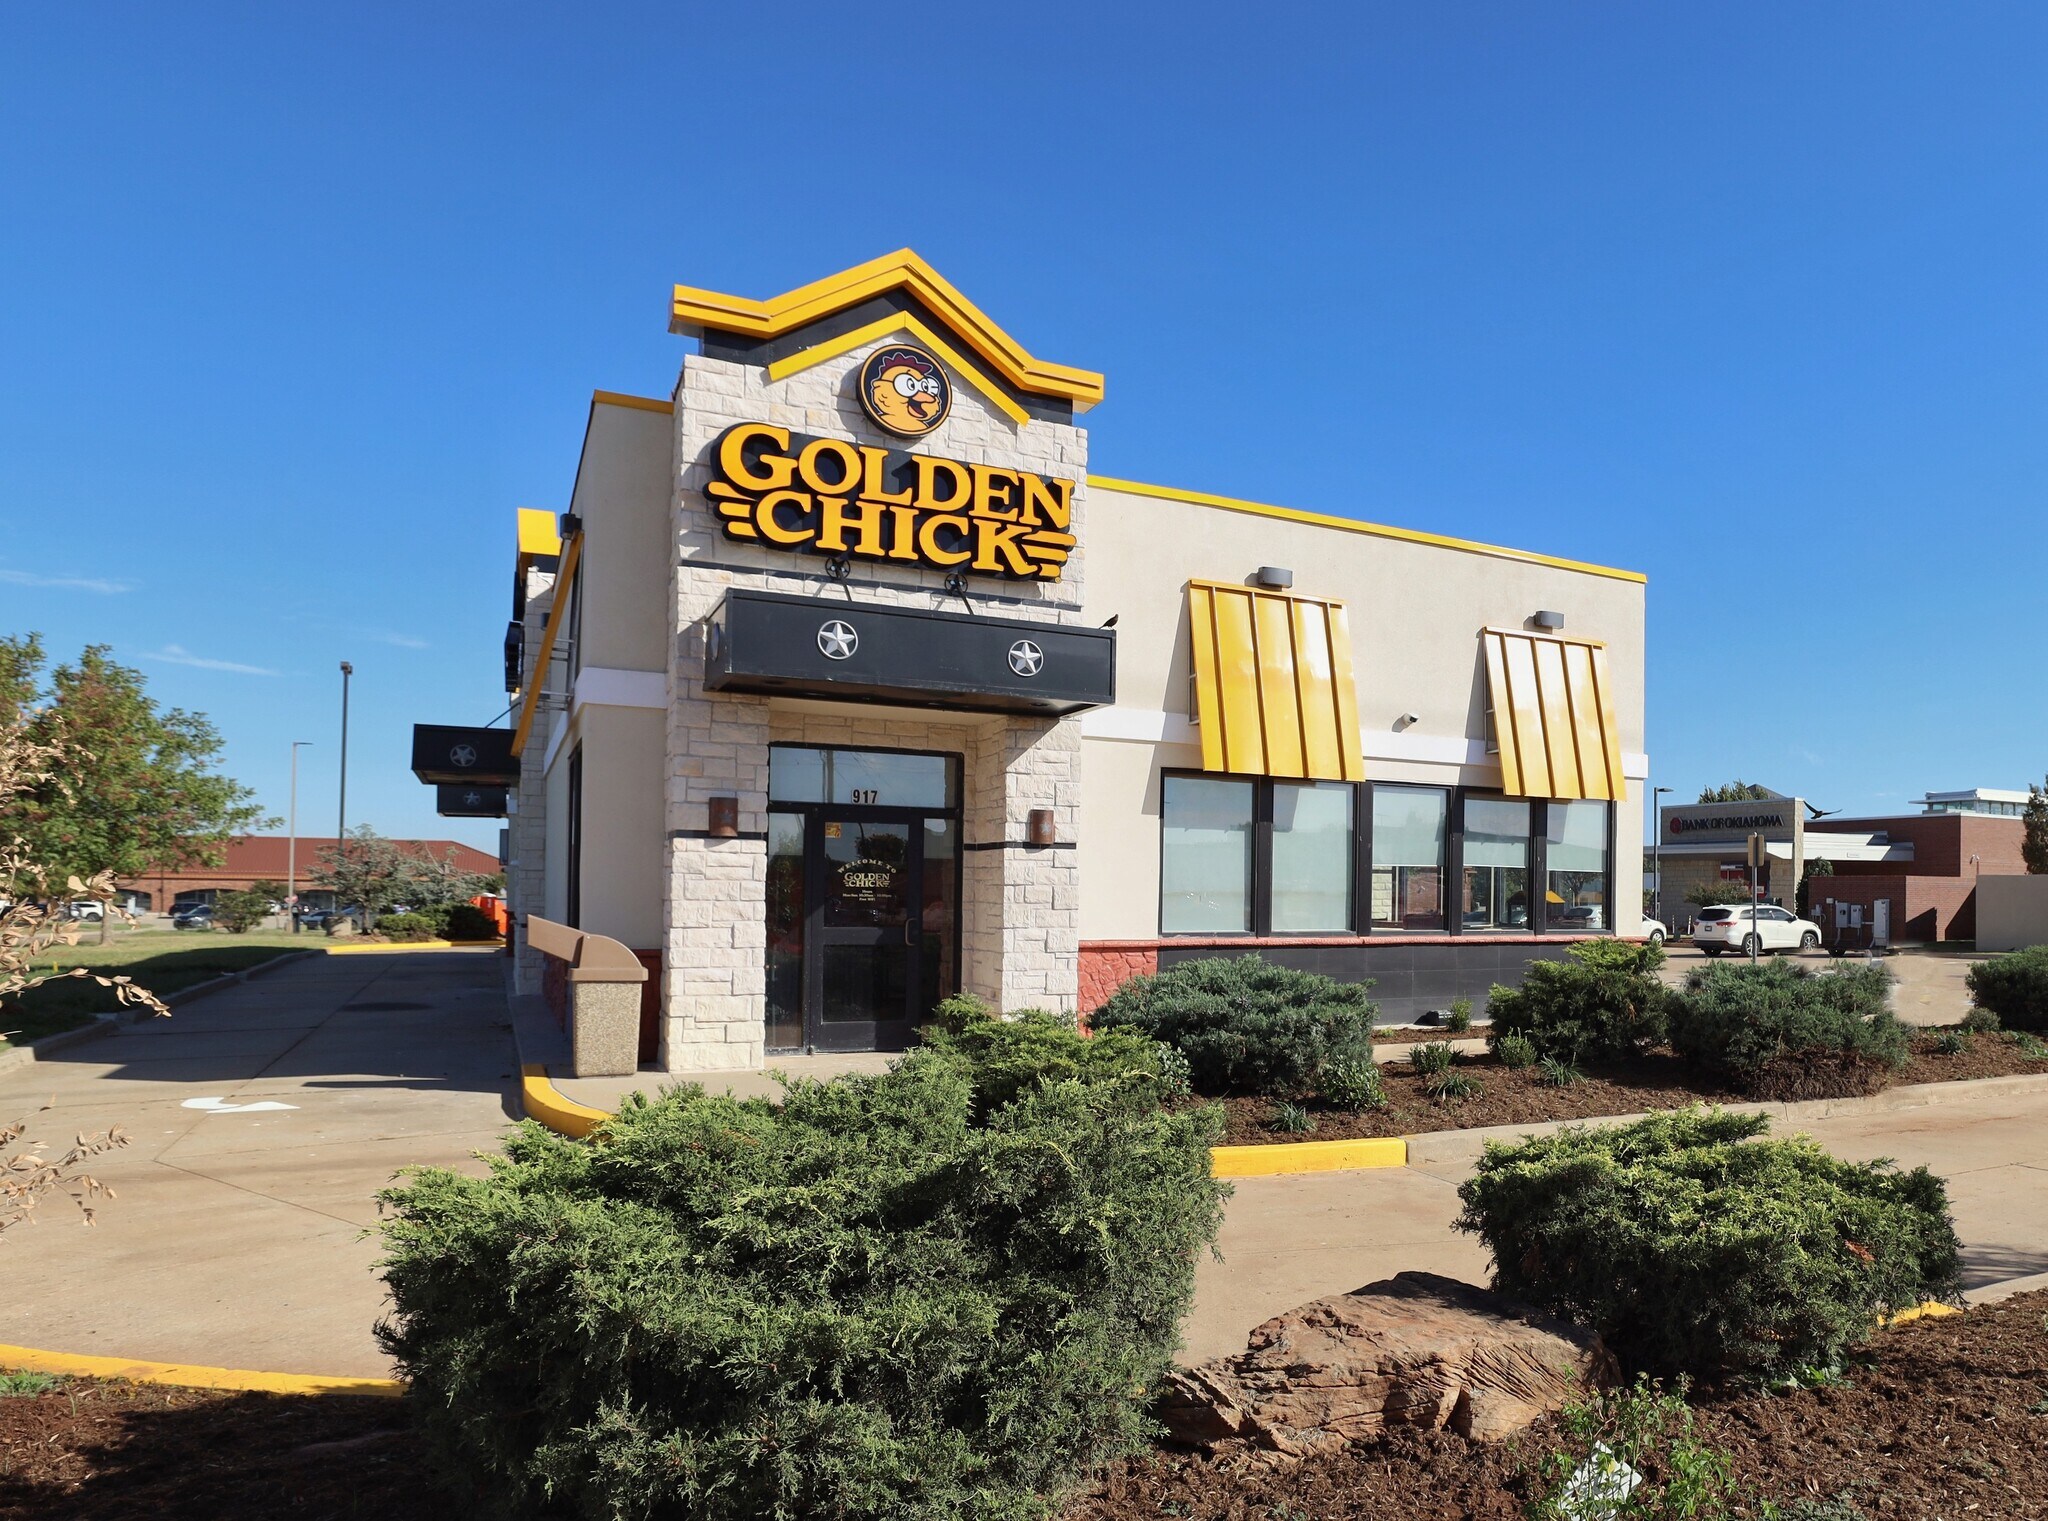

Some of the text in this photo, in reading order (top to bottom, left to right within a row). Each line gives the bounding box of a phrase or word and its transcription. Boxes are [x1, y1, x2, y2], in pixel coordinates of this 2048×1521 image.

[719, 423, 1075, 529] GOLDEN
[755, 490, 1038, 576] CHICK
[853, 789, 878, 804] 917
[1681, 817, 1709, 831] BANK
[837, 858, 897, 873] WELCOME TO
[844, 872, 890, 881] GOLDEN
[848, 879, 885, 888] CHICK
